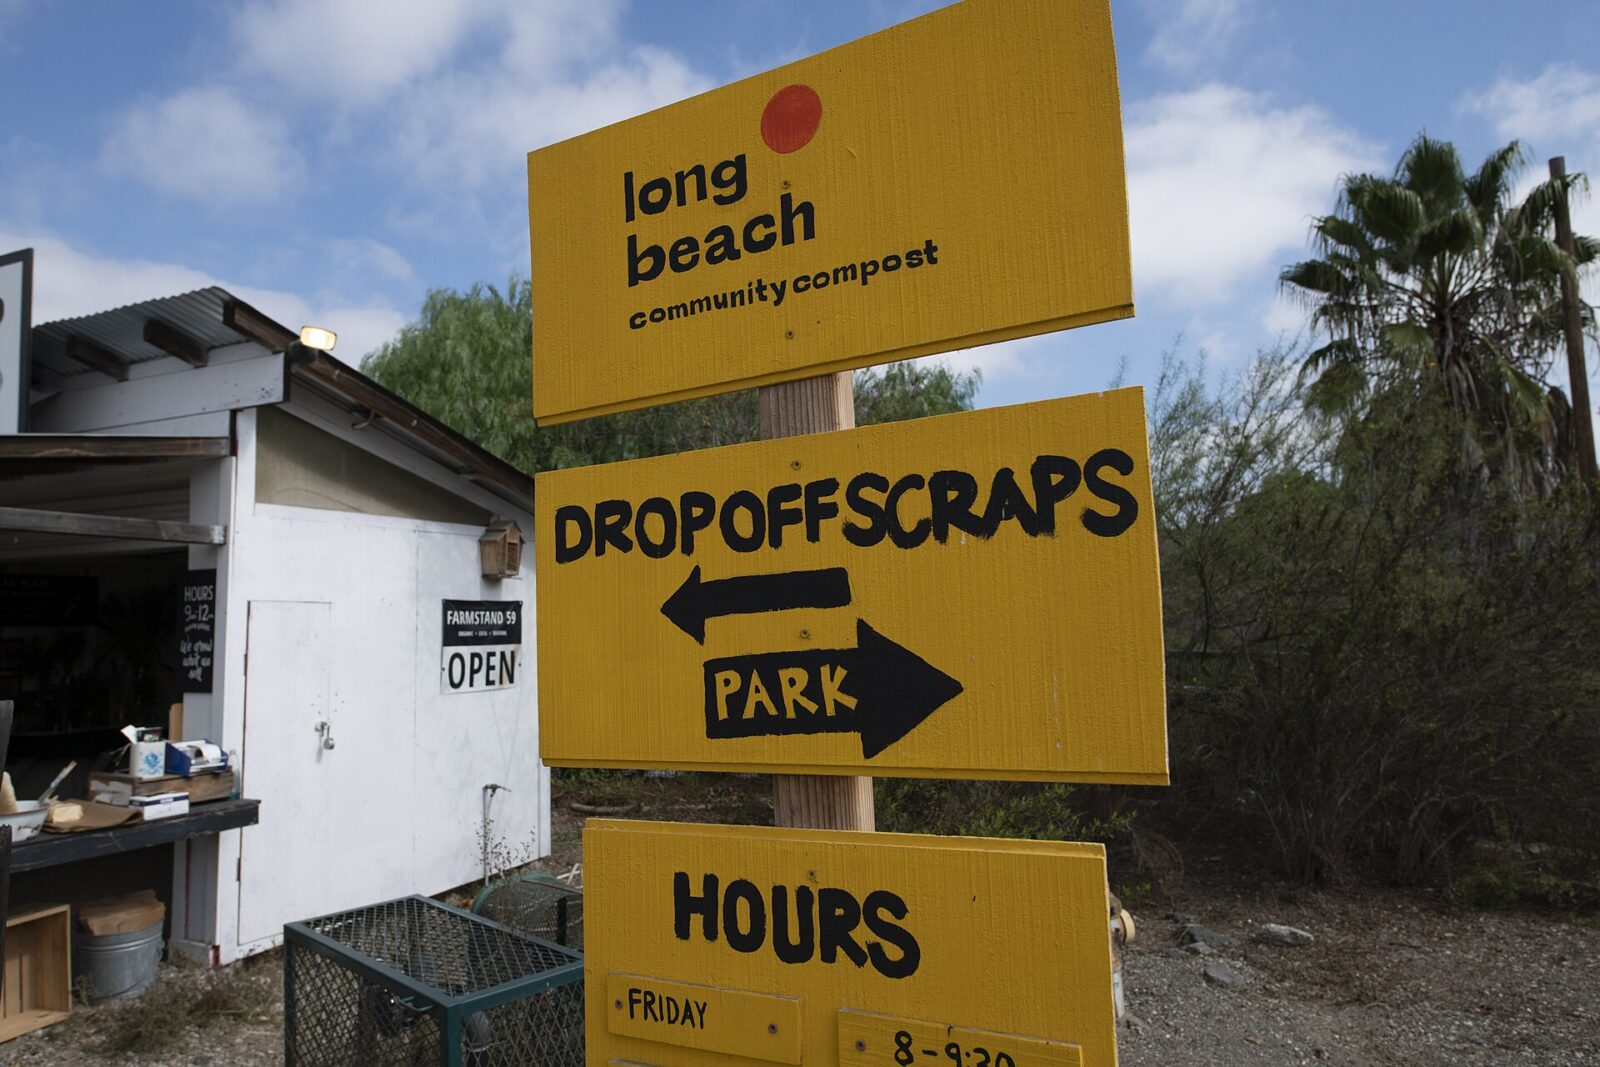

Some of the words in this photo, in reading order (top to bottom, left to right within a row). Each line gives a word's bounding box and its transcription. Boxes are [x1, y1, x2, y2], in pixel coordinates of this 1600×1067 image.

[624, 153, 747, 222] long
[627, 192, 815, 287] beach
[629, 278, 787, 329] community
[792, 239, 938, 294] compost
[184, 585, 214, 602] HOURS
[447, 610, 504, 625] FARMSTAND
[506, 611, 517, 625] 59
[448, 651, 516, 690] OPEN
[714, 664, 858, 721] PARK
[674, 872, 920, 979] HOURS
[628, 988, 708, 1029] FRIDAY
